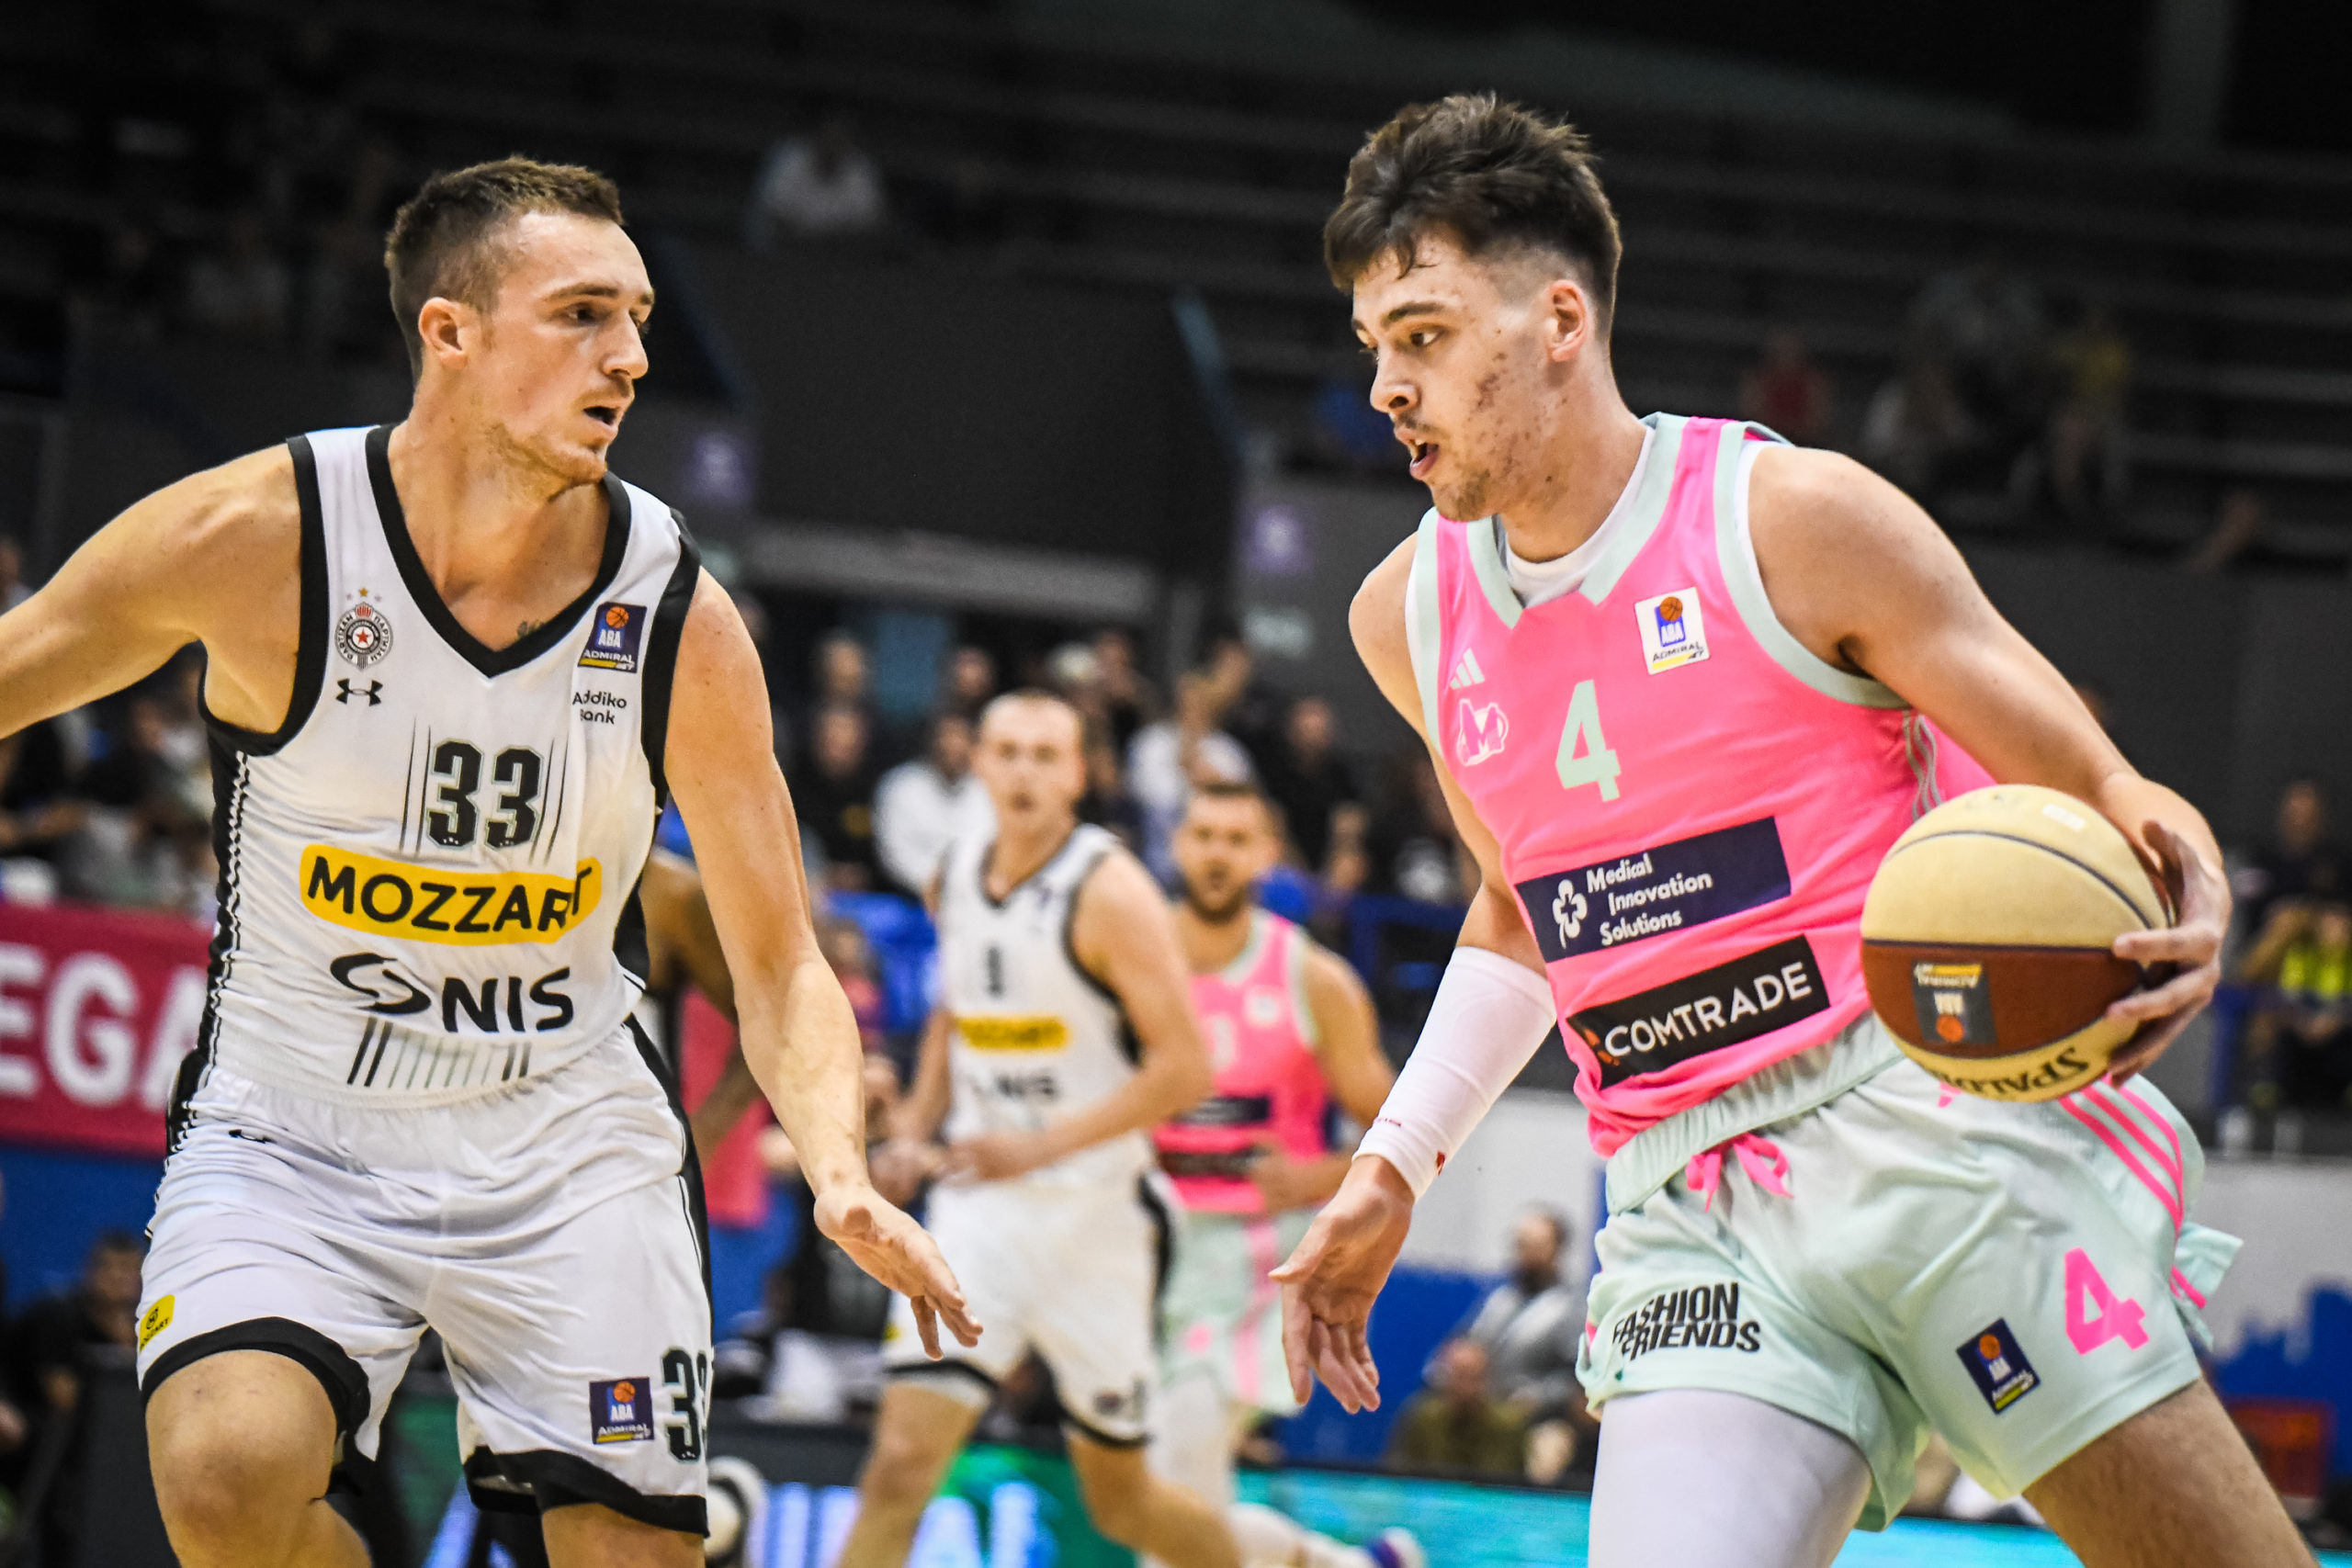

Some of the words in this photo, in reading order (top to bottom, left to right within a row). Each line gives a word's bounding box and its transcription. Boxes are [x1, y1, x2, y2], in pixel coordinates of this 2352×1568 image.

[582, 649, 634, 662] ADMIRAL
[597, 628, 622, 649] ABA
[1555, 679, 1622, 803] 4
[425, 738, 545, 851] 33
[1587, 852, 1653, 894] Medical
[1608, 873, 1713, 917] Innovation
[1600, 910, 1682, 947] Solutions
[441, 966, 574, 1033] NIS
[1604, 962, 1812, 1057] COMTRADE
[1612, 1281, 1739, 1345] FASHION
[2064, 1247, 2150, 1355] 4
